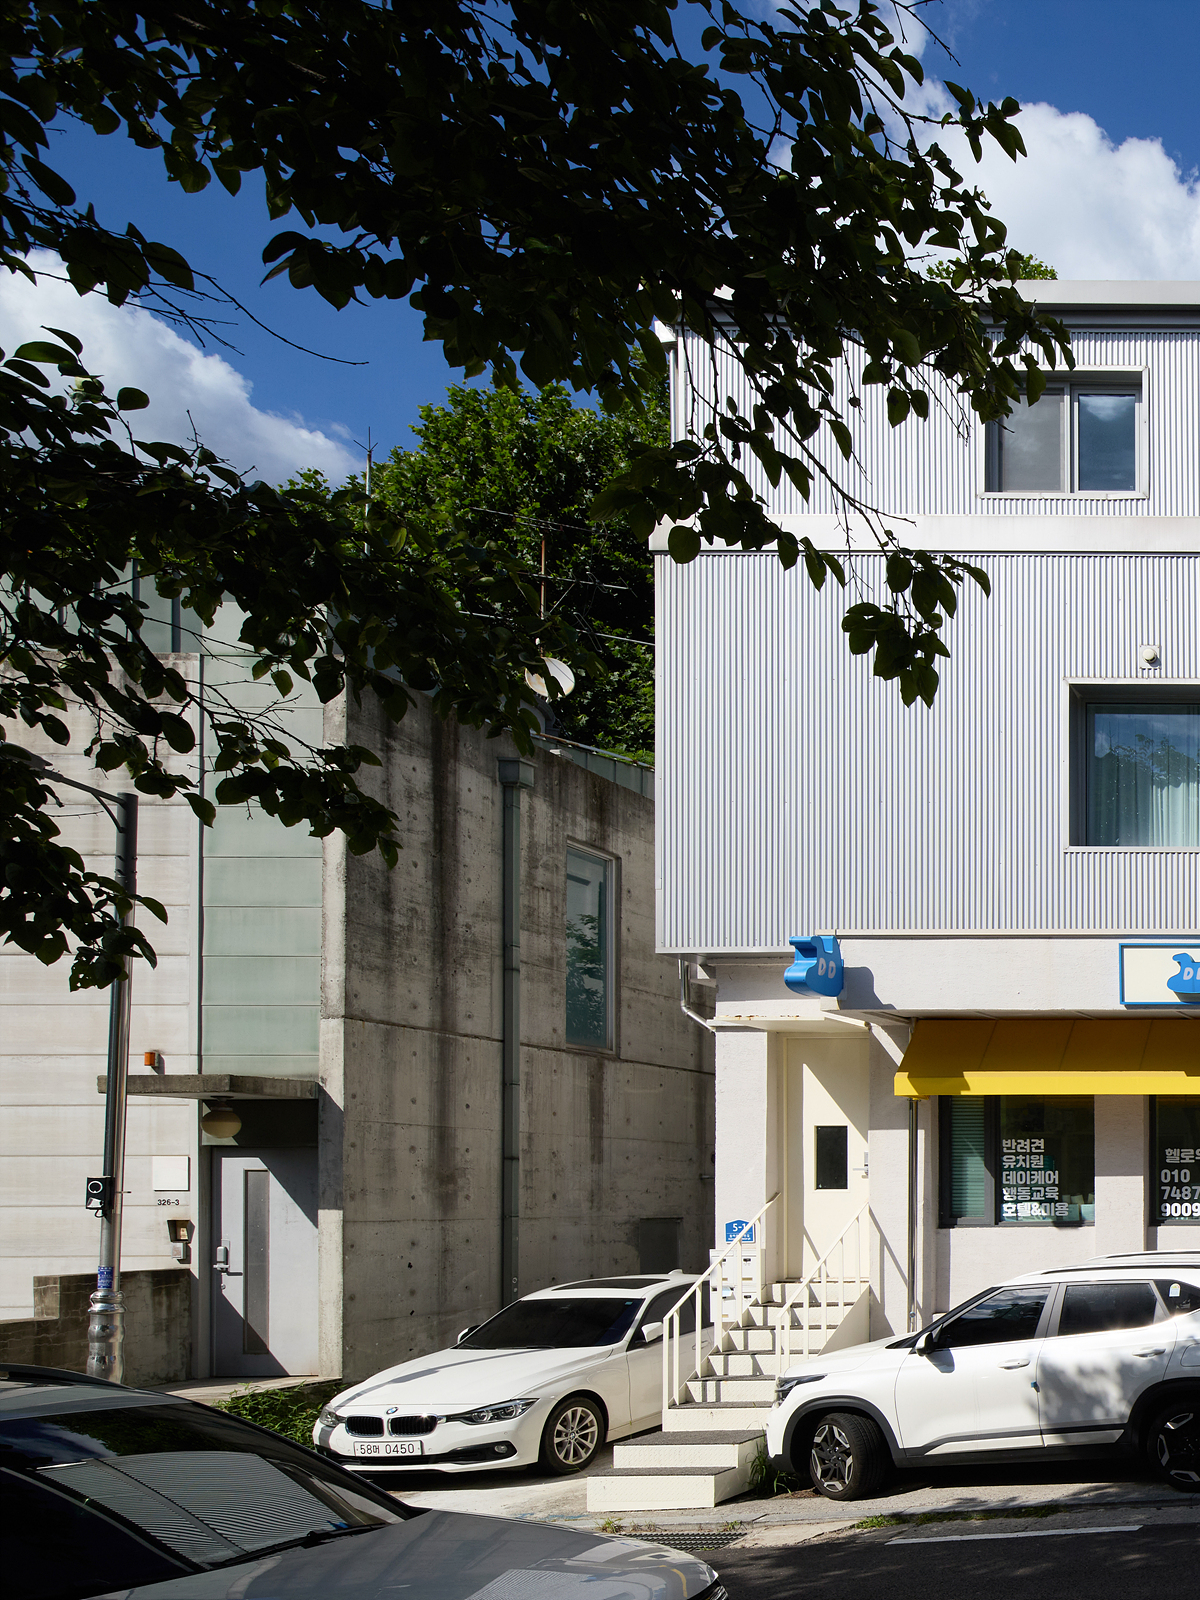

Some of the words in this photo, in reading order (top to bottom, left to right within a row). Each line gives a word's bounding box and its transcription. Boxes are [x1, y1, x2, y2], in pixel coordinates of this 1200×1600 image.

[1002, 1138, 1045, 1153] 반려견
[1002, 1154, 1044, 1169] 유치원
[1002, 1170, 1059, 1185] 데이케어
[1161, 1169, 1191, 1183] 010
[1002, 1186, 1059, 1201] 행동교육
[157, 1198, 180, 1206] 326-3
[1002, 1202, 1069, 1217] 호텔&미용
[385, 1443, 415, 1454] 0450
